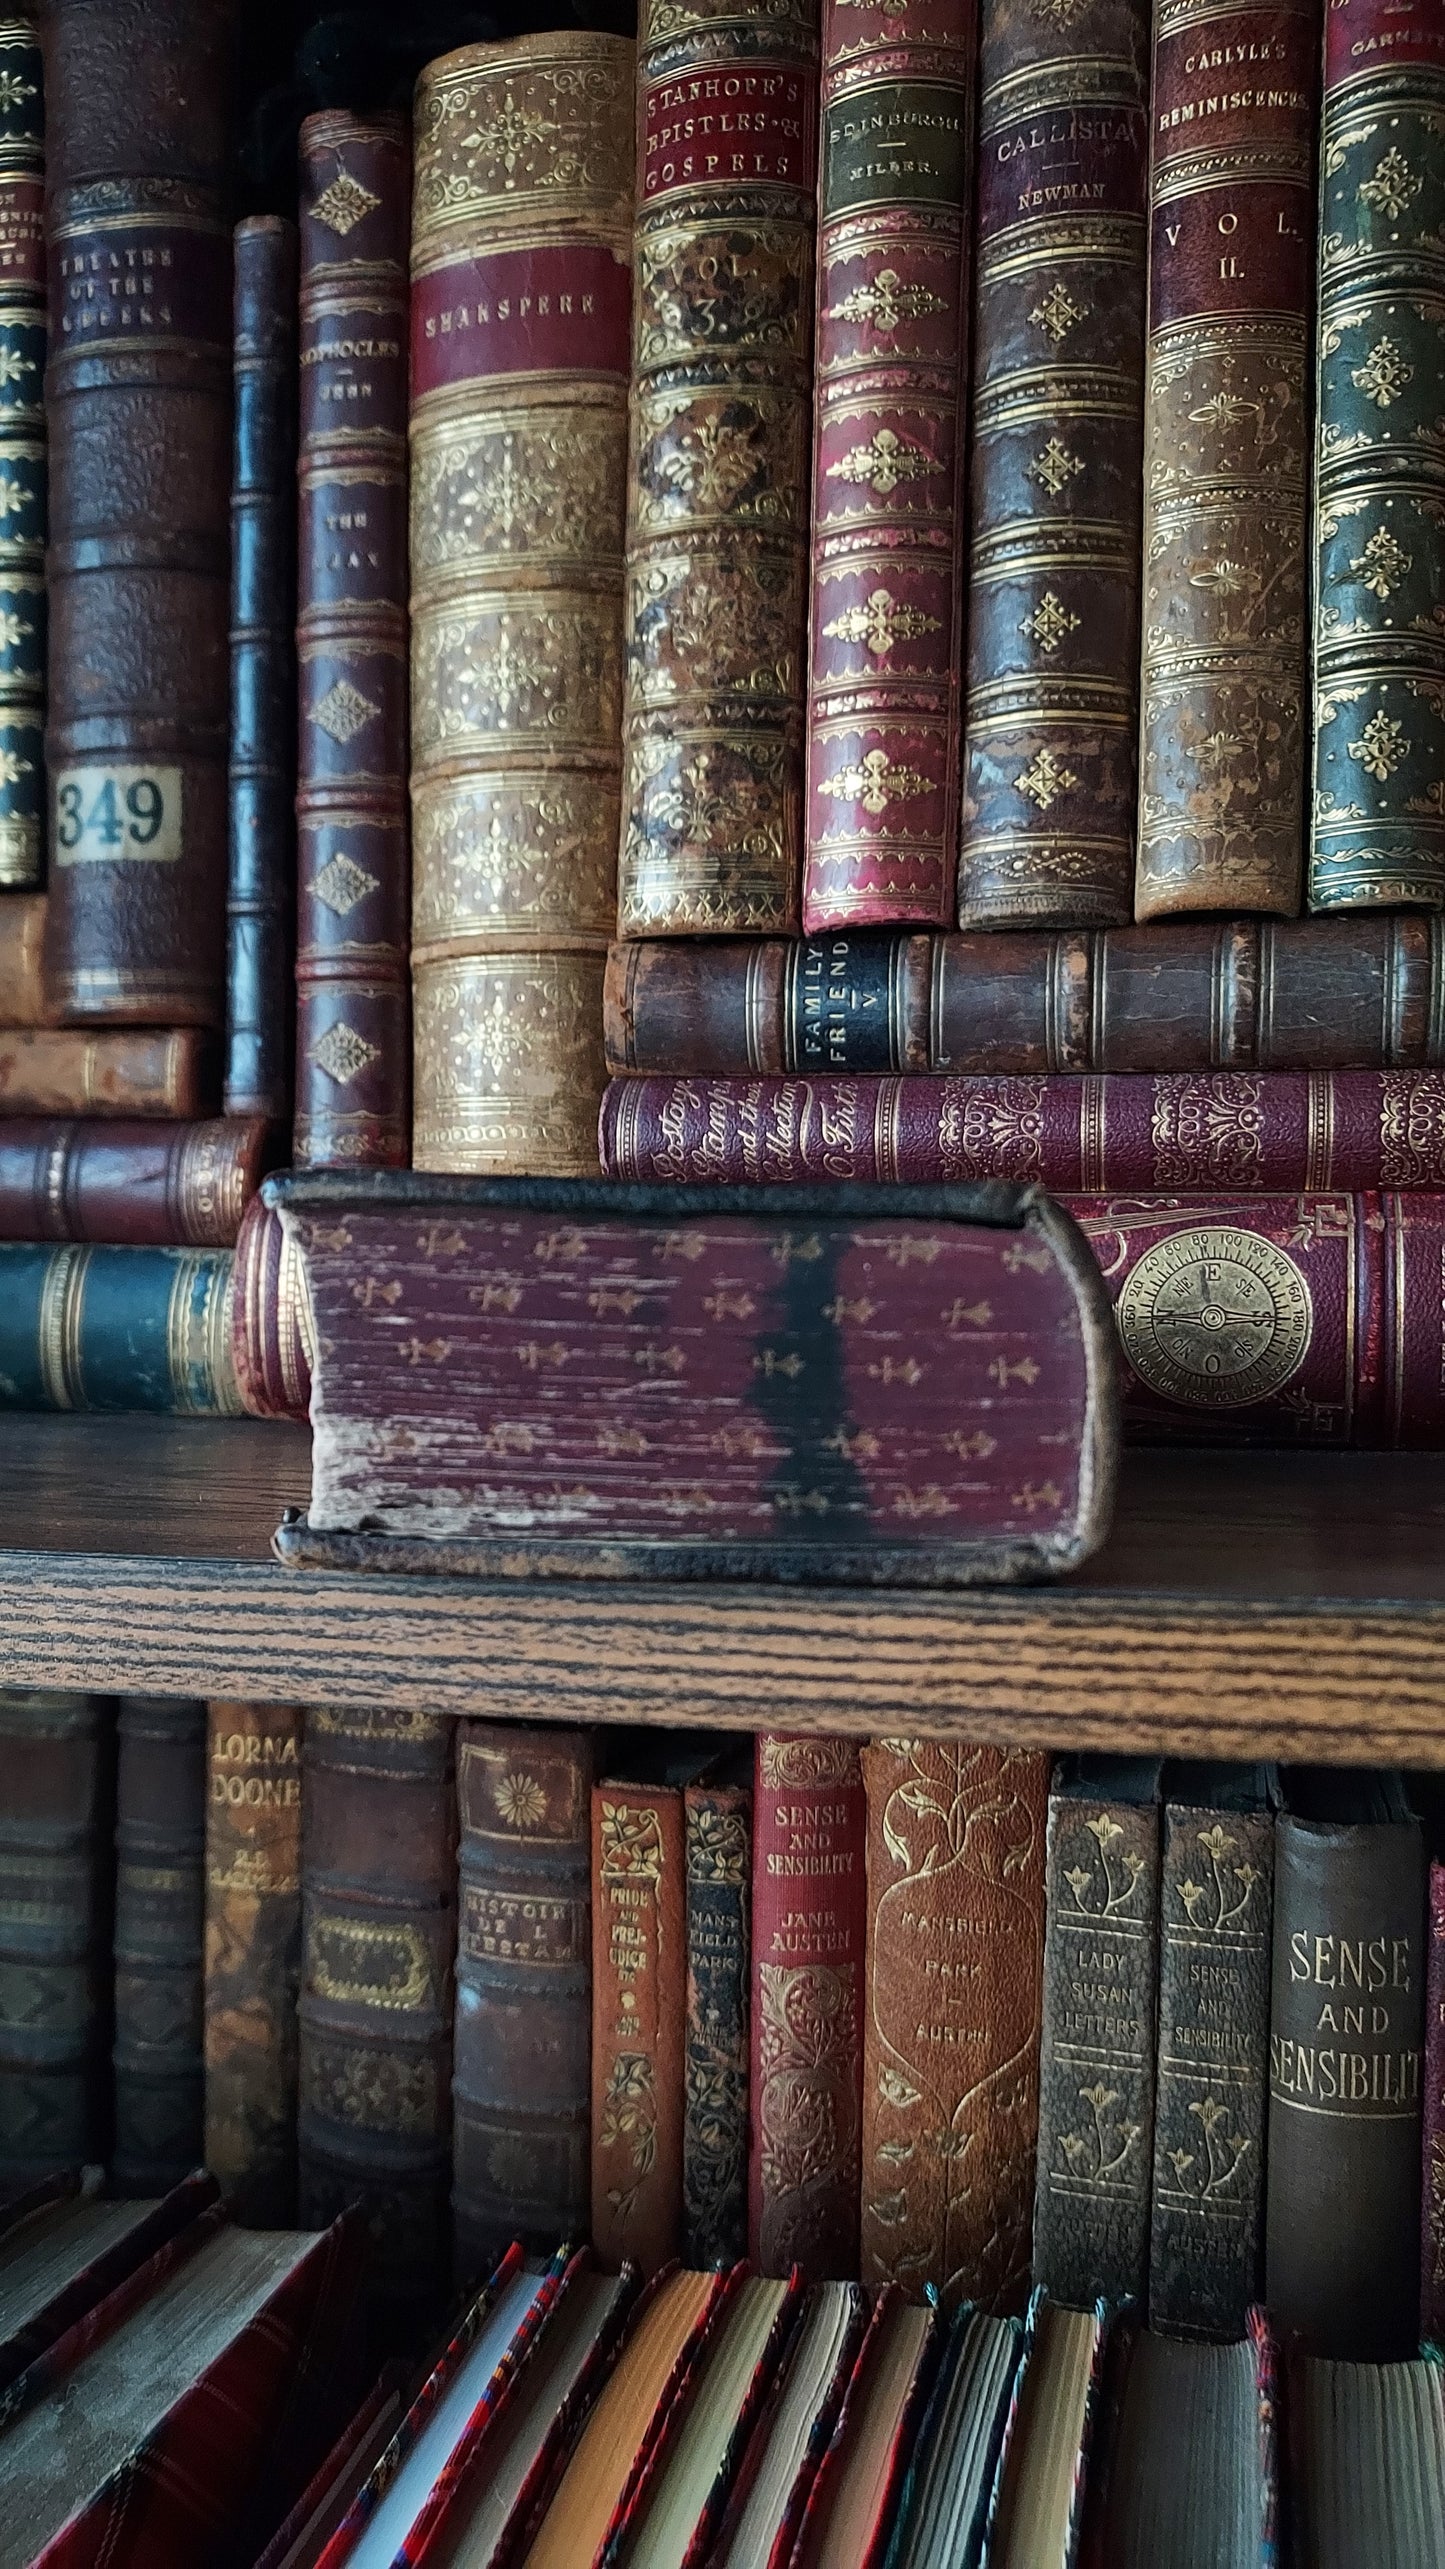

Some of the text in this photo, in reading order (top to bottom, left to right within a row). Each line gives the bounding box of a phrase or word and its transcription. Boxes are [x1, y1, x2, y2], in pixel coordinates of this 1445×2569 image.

[1185, 36, 1286, 74] CARLYLE'S
[647, 75, 798, 119] STANHOPE'S
[997, 120, 1131, 162] CALLISTA
[646, 154, 788, 190] GOSPELS
[1017, 184, 1106, 211] NEWMAN
[1219, 256, 1245, 279] II.
[108, 276, 154, 296] THE
[425, 294, 594, 338] SHAKSPERE
[59, 778, 164, 848] 349
[804, 948, 823, 1053] FAMILY
[829, 941, 849, 1062] FRIEND
[820, 1081, 859, 1153] Firth
[691, 1080, 736, 1184] Stamps
[762, 1080, 800, 1182] Collection
[1164, 1241, 1182, 1256] 60
[1192, 1234, 1209, 1246] 80
[1220, 1233, 1243, 1247] 100
[1248, 1240, 1268, 1258] 120
[1144, 1256, 1160, 1274] 40
[1205, 1263, 1222, 1281] E
[1270, 1256, 1290, 1277] 140
[1129, 1280, 1145, 1298] 20
[1286, 1280, 1302, 1303] 160
[1125, 1304, 1136, 1329] 360
[1293, 1309, 1305, 1332] 180
[1285, 1336, 1302, 1360] 200
[1205, 1354, 1220, 1374] O
[211, 1733, 299, 1764] LORNA
[211, 1774, 300, 1806] DOONE
[775, 1804, 846, 1827] SENSE
[789, 1833, 831, 1850] AND
[767, 1853, 854, 1876] SENSIBILITY
[610, 1887, 648, 1908] PRIDE
[781, 1912, 836, 1928] JANE
[770, 1931, 850, 1951] AUSTEN
[609, 1947, 647, 1969] UDICE
[924, 1960, 984, 1978] PARK
[1079, 1950, 1125, 1970] LADY
[1288, 1930, 1410, 1993] SENSE
[1189, 1965, 1240, 1985] SENSE
[1071, 1981, 1132, 2005] SUSAN
[1197, 1998, 1230, 2016] AND
[1316, 2003, 1389, 2034] AND
[914, 2023, 992, 2043] AUSTEN
[1065, 2011, 1140, 2036] LETTERS
[1175, 2026, 1250, 2049] SENSIBILITY
[1270, 2033, 1419, 2104] SENSIBILIT
